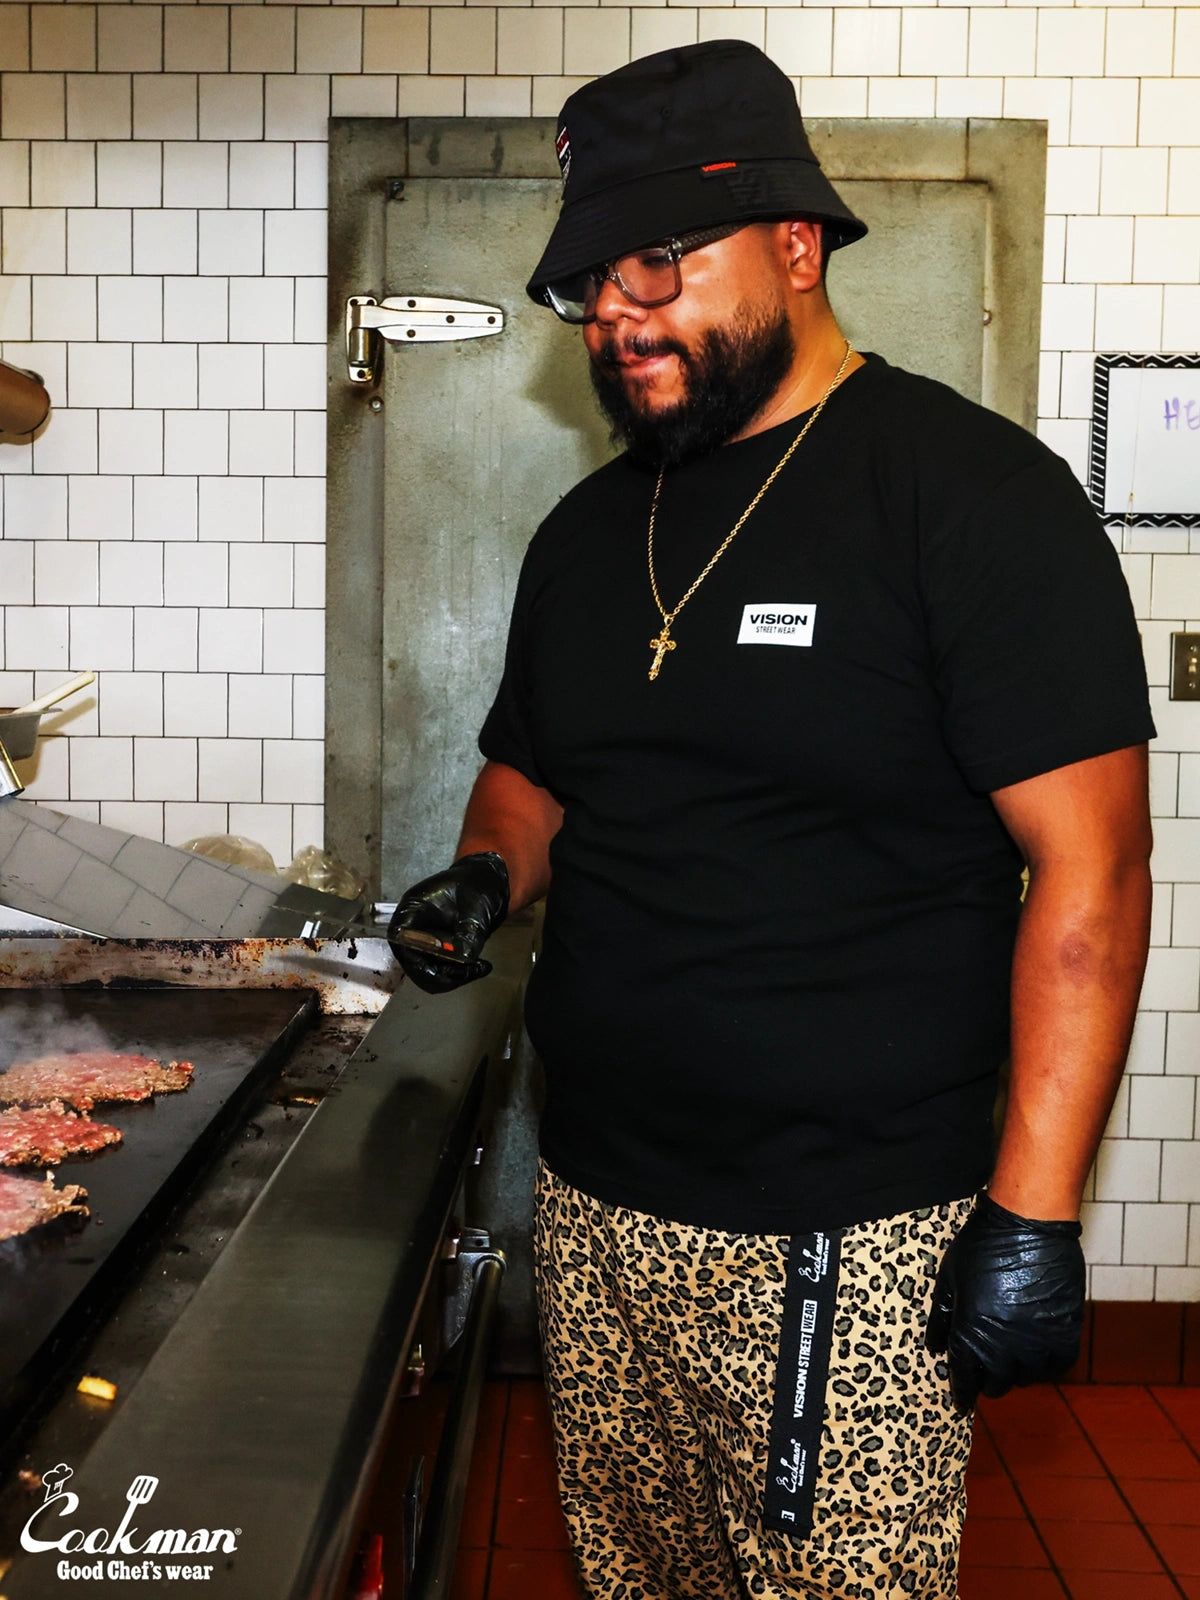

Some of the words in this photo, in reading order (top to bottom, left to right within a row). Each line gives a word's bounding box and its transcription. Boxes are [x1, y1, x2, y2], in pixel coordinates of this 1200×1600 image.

[750, 613, 808, 626] VISION
[802, 1302, 816, 1330] WEAR
[798, 1332, 813, 1368] STREET
[793, 1368, 808, 1418] VISION
